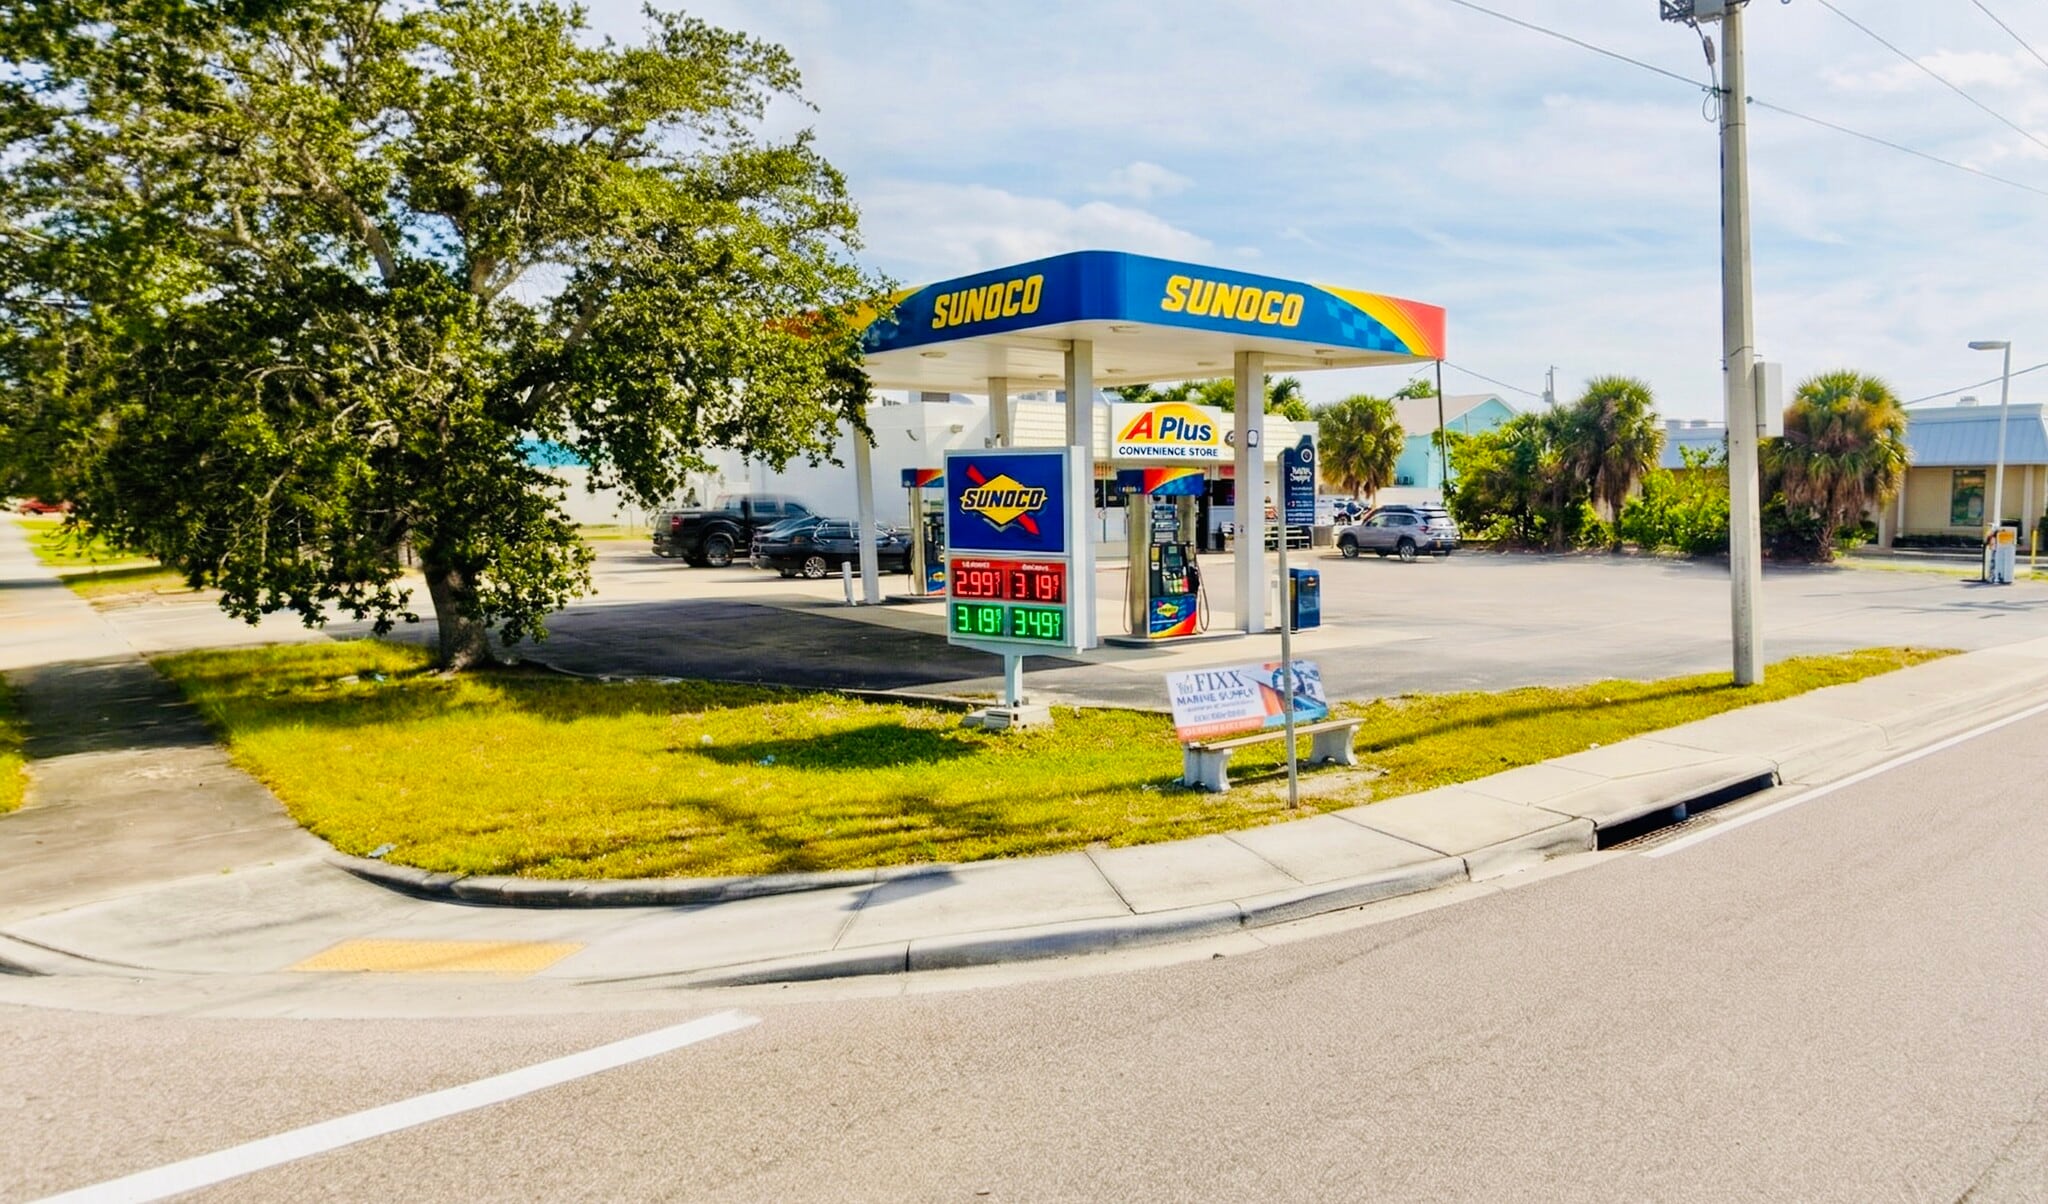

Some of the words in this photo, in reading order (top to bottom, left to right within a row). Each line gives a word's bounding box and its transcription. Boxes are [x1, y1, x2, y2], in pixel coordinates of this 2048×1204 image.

[931, 272, 1044, 330] SUNOCO
[1161, 274, 1305, 328] SUNOCO
[1124, 410, 1154, 440] A
[1159, 416, 1212, 442] Plus
[1118, 446, 1186, 456] CONVENIENCE
[1188, 447, 1219, 457] STORE
[963, 489, 1043, 508] SUNOCO
[1194, 670, 1244, 691] FIXX
